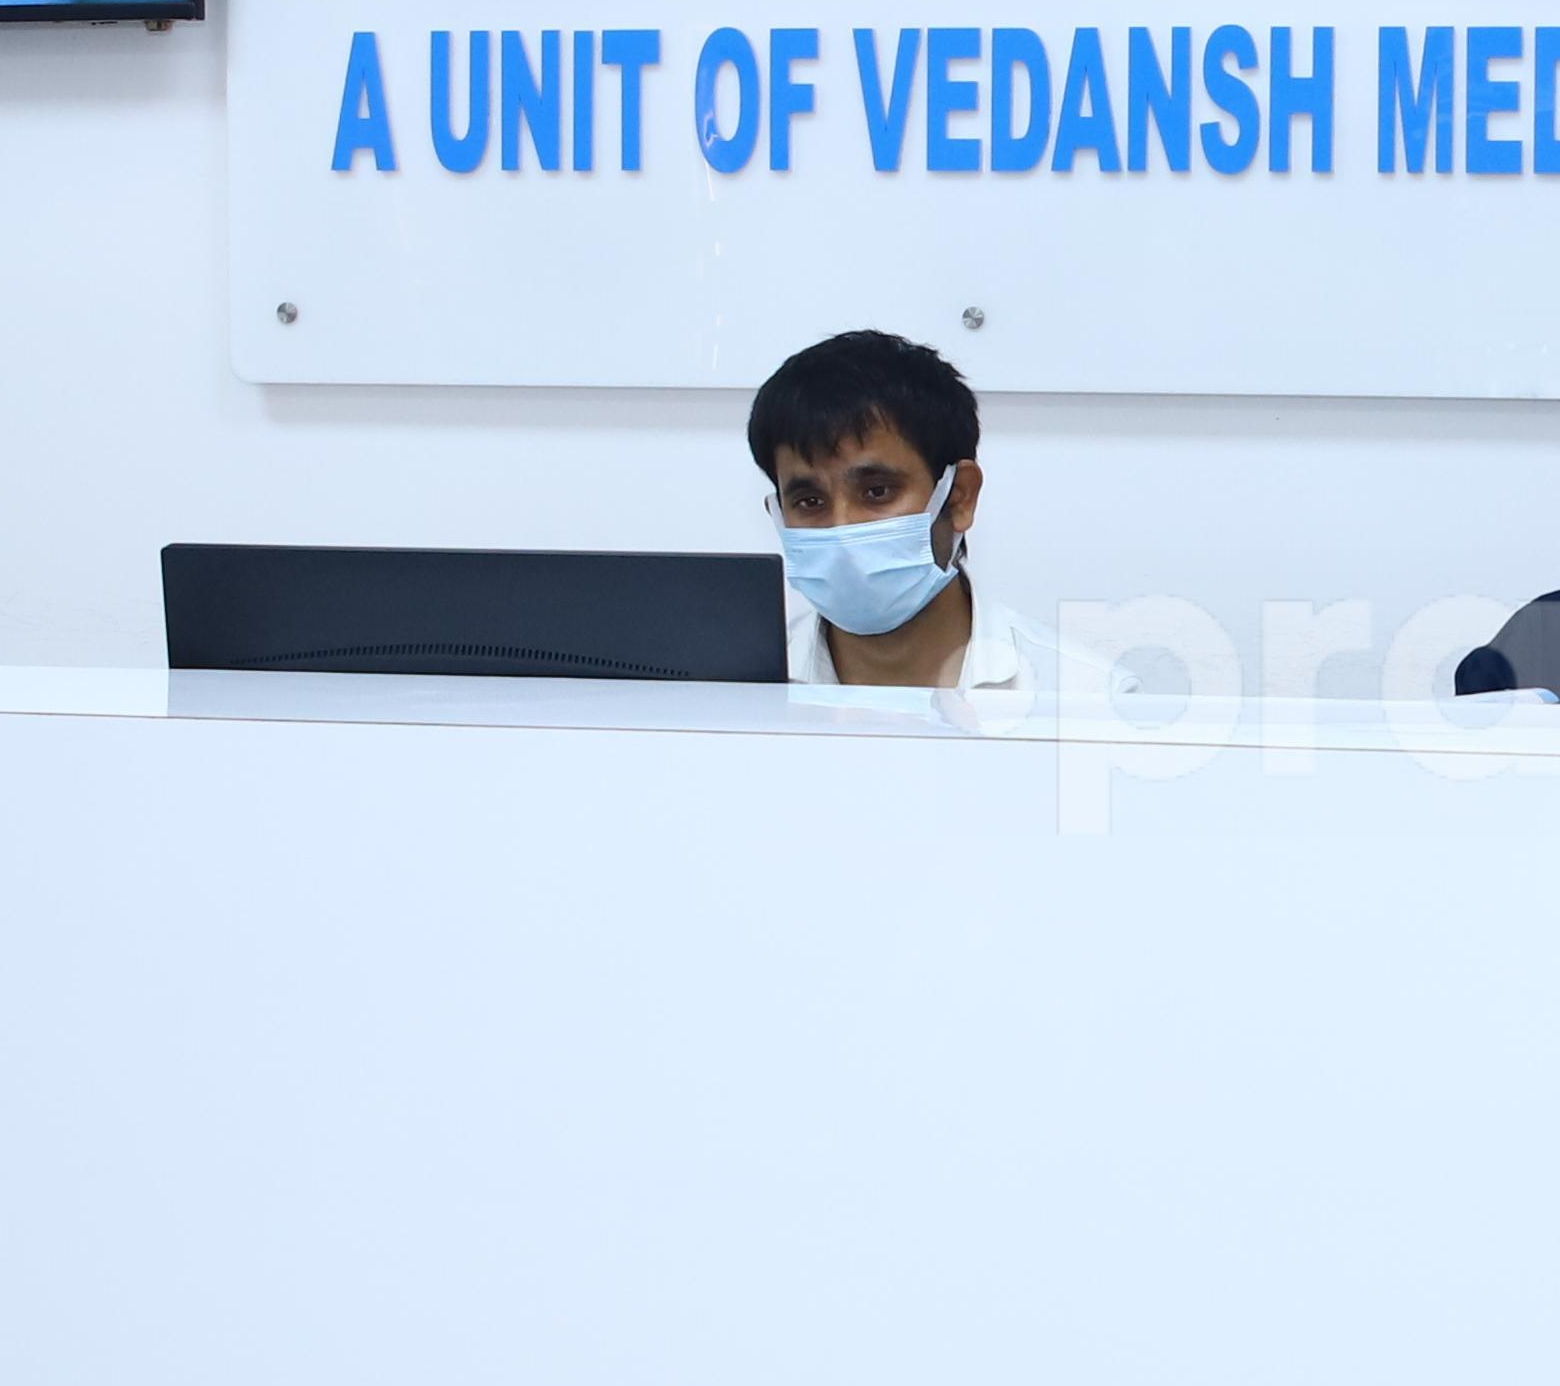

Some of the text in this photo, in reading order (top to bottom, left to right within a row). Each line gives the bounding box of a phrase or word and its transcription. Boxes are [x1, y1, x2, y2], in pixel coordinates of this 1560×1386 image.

[331, 31, 398, 173] A
[429, 28, 662, 174] UNIT
[694, 26, 821, 174] OF
[853, 24, 1335, 175] VEDANSH
